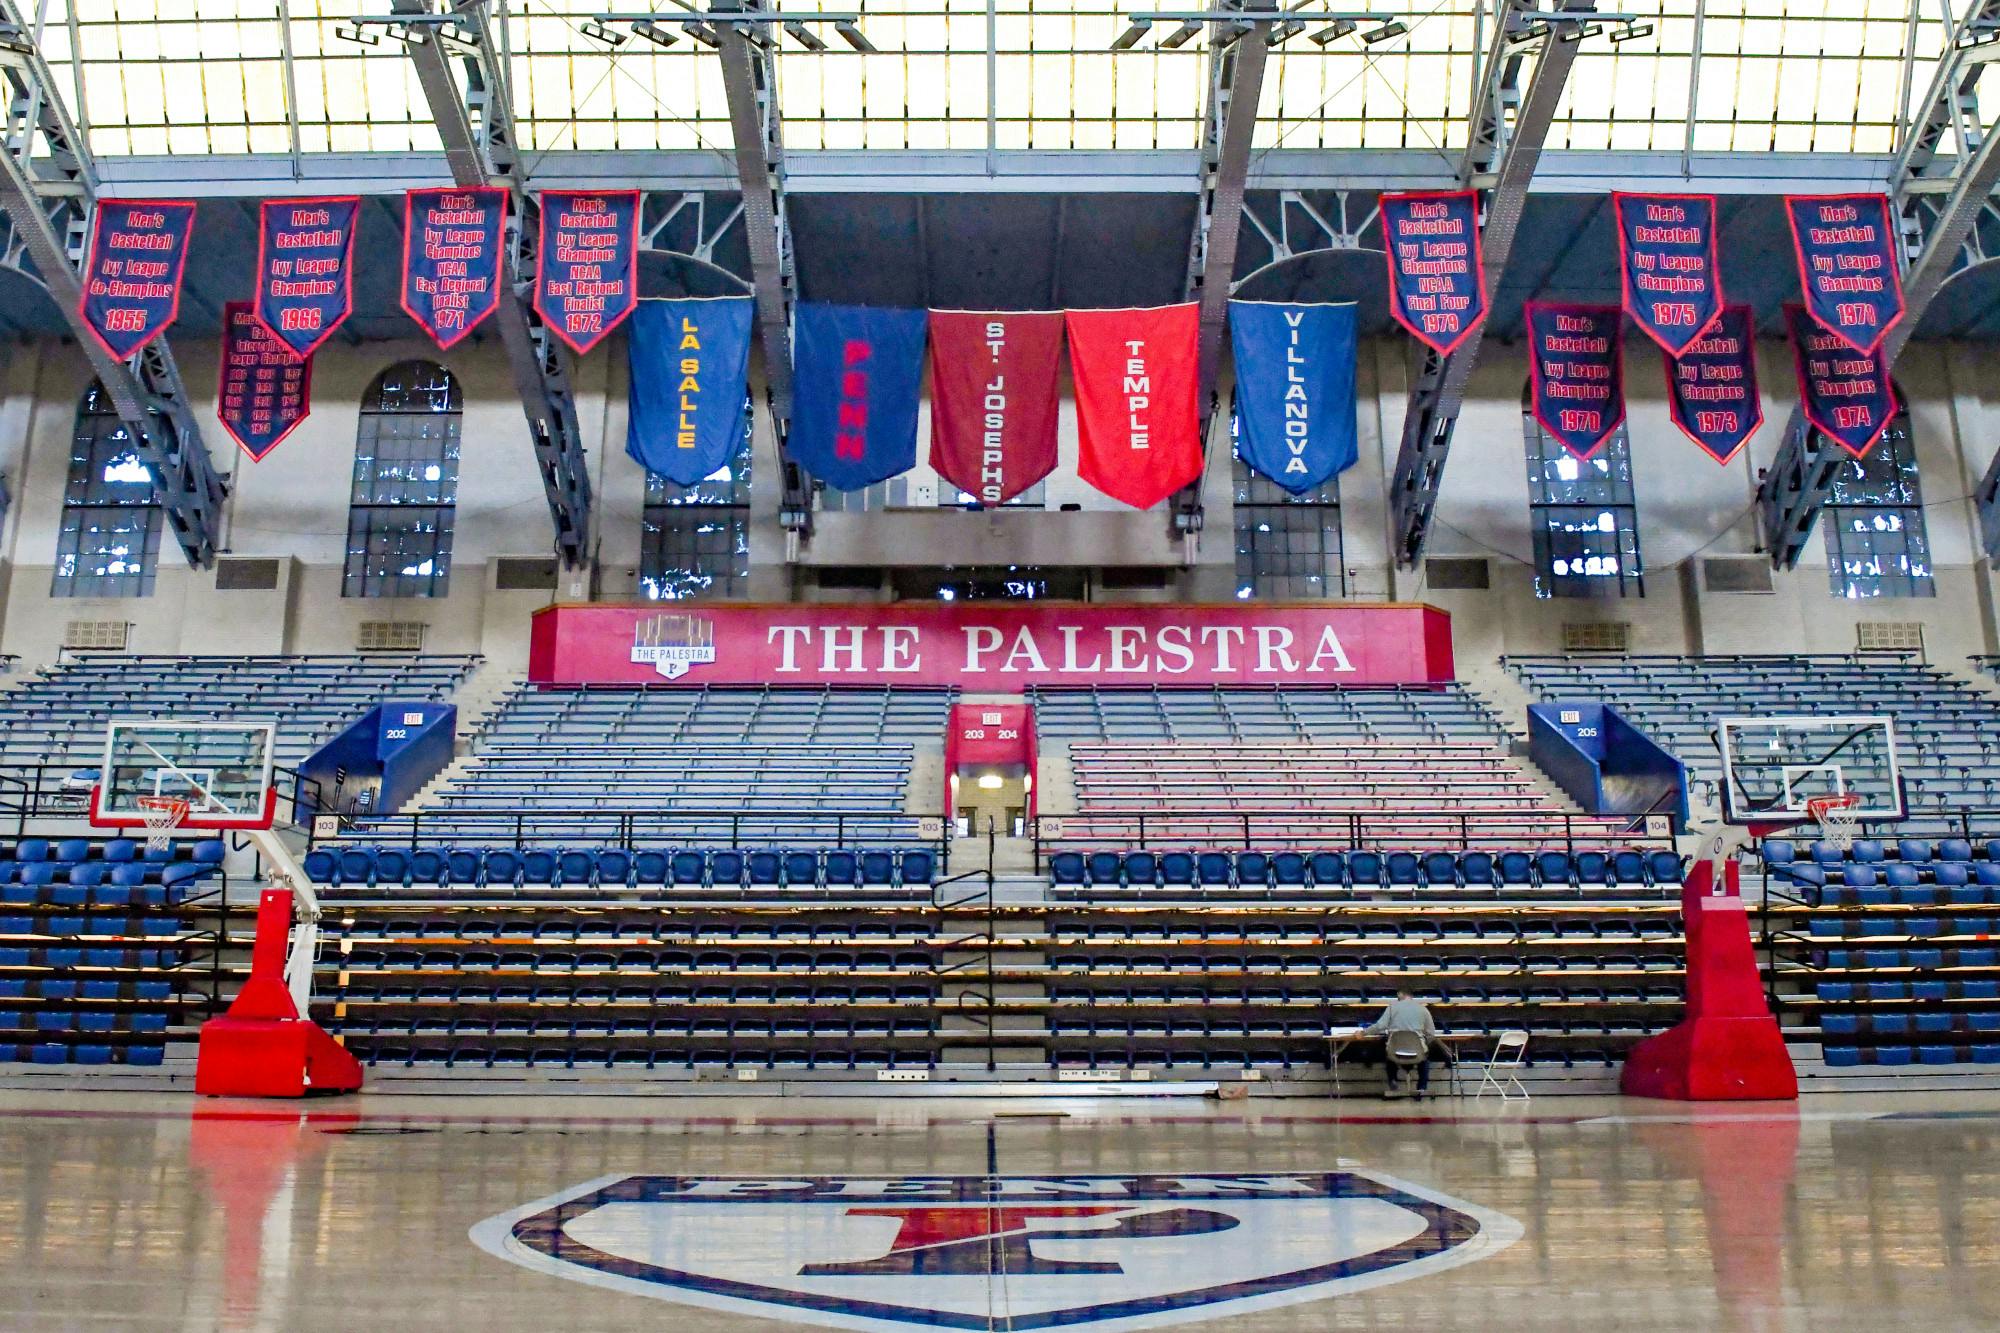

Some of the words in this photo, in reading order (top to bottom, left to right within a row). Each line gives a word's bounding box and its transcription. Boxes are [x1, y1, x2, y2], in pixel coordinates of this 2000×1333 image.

[441, 195, 475, 210] Men's
[573, 198, 607, 213] Men's
[1410, 202, 1448, 219] Men's
[128, 211, 164, 228] Men's
[291, 209, 330, 226] Men's
[428, 209, 485, 225] Basketball
[560, 213, 617, 228] Basketball
[1647, 204, 1685, 222] Men's
[1820, 204, 1857, 222] Men's
[425, 227, 443, 245] Ivy
[445, 228, 485, 244] League
[1399, 218, 1462, 236] Basketball
[1636, 225, 1701, 244] Basketball
[1811, 226, 1874, 244] Basketball
[110, 232, 173, 249] Basketball
[277, 230, 341, 248] Basketball
[557, 231, 577, 248] Ivy
[579, 232, 619, 248] League
[425, 244, 482, 260] Champions
[557, 248, 616, 264] Champions
[1399, 241, 1419, 260] Ivy
[1423, 241, 1467, 258] League
[102, 259, 122, 276] Ivy
[125, 259, 169, 278] League
[271, 258, 292, 277] Ivy
[296, 258, 339, 275] League
[437, 261, 467, 277] NCAA
[1402, 258, 1467, 276] Champions
[1634, 252, 1656, 271] Ivy
[1659, 252, 1704, 273] League
[1813, 254, 1834, 273] Ivy
[1837, 254, 1881, 272] League
[570, 265, 602, 280] NCAA
[90, 278, 172, 299] Co-Champions
[271, 279, 336, 298] Champions
[416, 277, 437, 294] Eas
[441, 277, 487, 293] Regional
[548, 280, 573, 296] East
[576, 280, 622, 296] Regional
[1419, 277, 1454, 293] NCAA
[1638, 273, 1705, 294] Champions
[1819, 274, 1883, 292] Champions
[564, 296, 605, 311] Finalist
[1407, 295, 1437, 310] Final
[1439, 295, 1469, 310] Four
[105, 309, 147, 331] 1955
[281, 308, 321, 331] 1966
[435, 309, 464, 330] 1971
[566, 312, 602, 333] 1972
[1422, 313, 1459, 333] 1979
[1652, 302, 1696, 326] 1975
[1557, 315, 1592, 332] Men's
[680, 317, 700, 350] LA
[986, 320, 1005, 363] ST.
[1546, 335, 1607, 353] Basketball
[1545, 360, 1564, 379] Ivy
[1567, 361, 1610, 380] League
[1678, 362, 1698, 382] Ivy
[1700, 363, 1743, 380] League
[1810, 359, 1829, 377] Ivy
[1832, 359, 1874, 376] League
[1122, 340, 1150, 450] TEMPLE
[1283, 311, 1309, 474] VILLANOVA
[1547, 381, 1610, 401] Champions
[1682, 383, 1745, 402] Champions
[1816, 379, 1877, 397] Champions
[677, 358, 700, 449] SALLE
[835, 339, 872, 463] PENN
[1559, 409, 1601, 433] 1970
[1695, 411, 1738, 433] 1973
[1832, 405, 1871, 429] 1974
[637, 649, 655, 660] THE
[659, 649, 710, 660] PALESTRA
[767, 625, 921, 673] THE
[960, 624, 1357, 674] PALESTRA
[668, 663, 678, 674] P
[406, 713, 421, 724] EXIT
[986, 713, 999, 723] EXIT
[1563, 712, 1577, 722] EXIT
[386, 729, 406, 739] 202
[964, 729, 985, 739] 203
[998, 729, 1018, 739] 204
[1577, 727, 1597, 737] 205
[318, 821, 335, 830] 103
[921, 822, 938, 831] 103
[1043, 822, 1060, 831] 104
[1650, 821, 1667, 830] 104
[659, 1177, 1317, 1196] PENN
